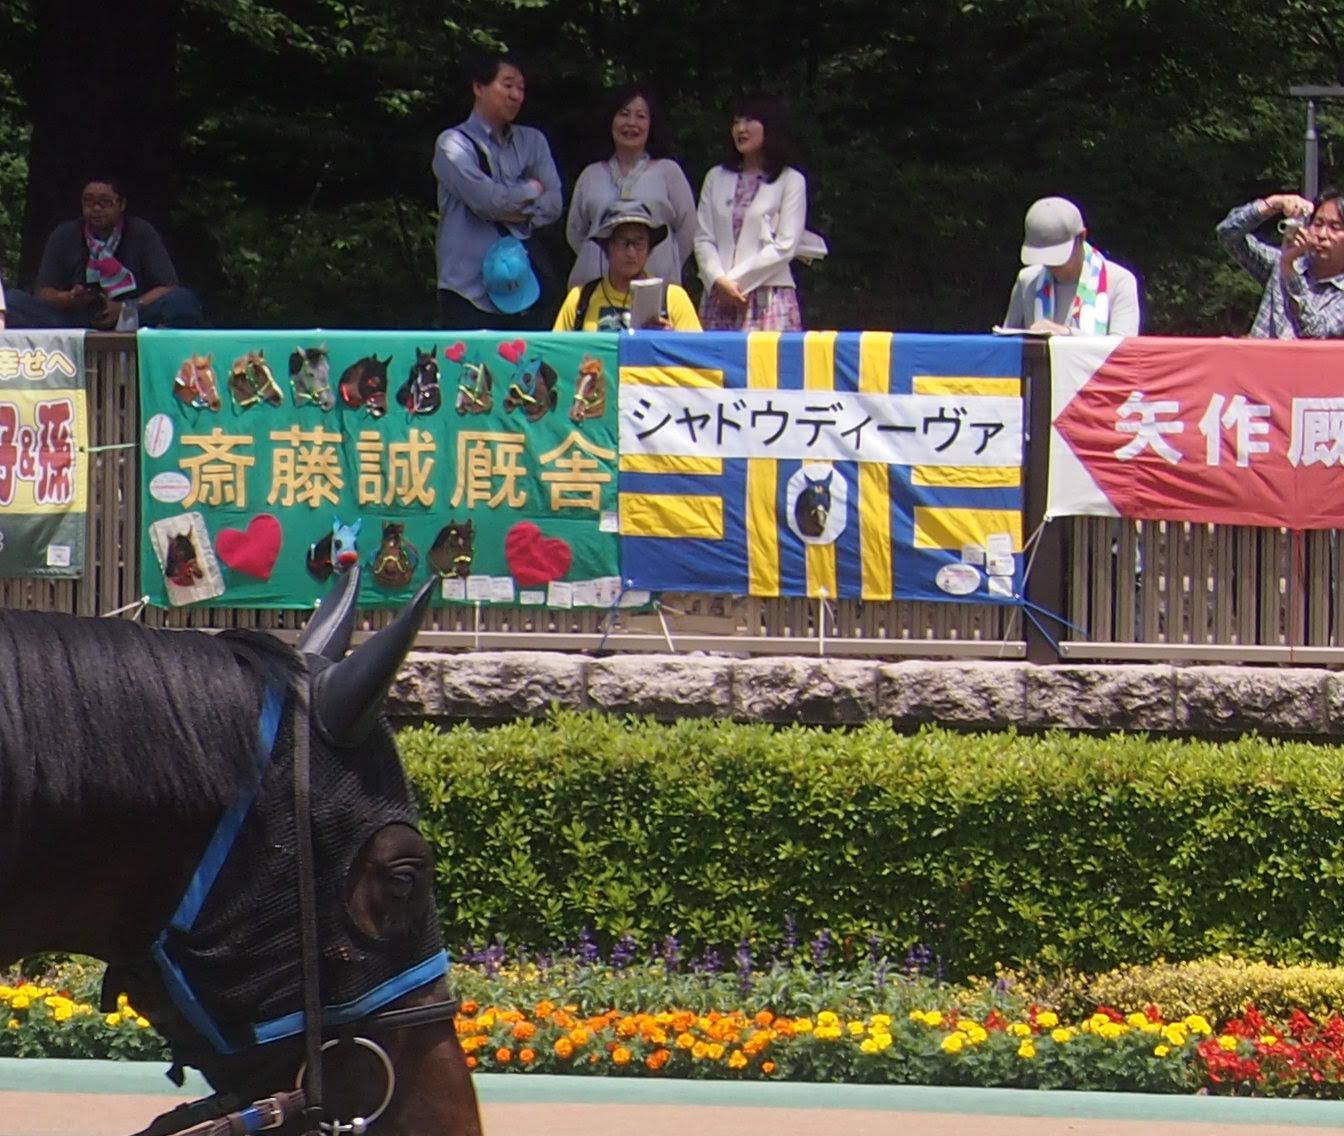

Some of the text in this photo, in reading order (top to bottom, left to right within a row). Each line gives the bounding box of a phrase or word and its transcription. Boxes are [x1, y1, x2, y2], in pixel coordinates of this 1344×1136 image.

[631, 398, 1005, 456] シャドウディーヴァ
